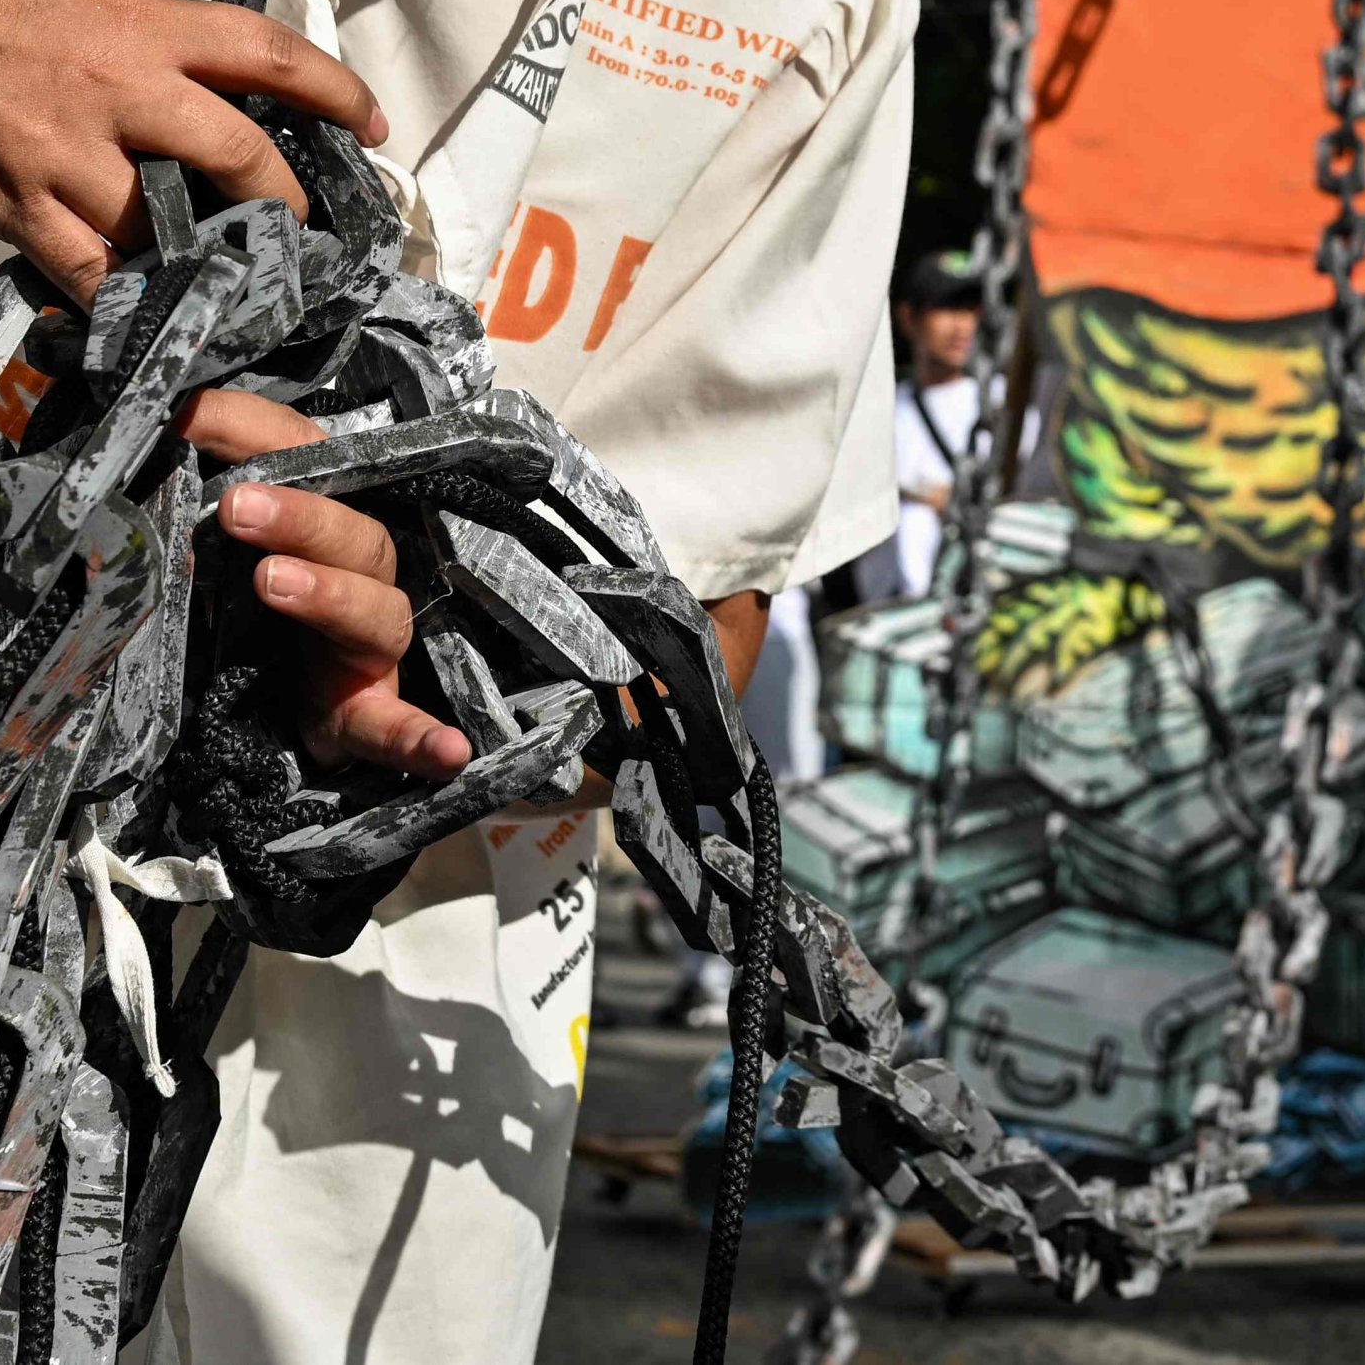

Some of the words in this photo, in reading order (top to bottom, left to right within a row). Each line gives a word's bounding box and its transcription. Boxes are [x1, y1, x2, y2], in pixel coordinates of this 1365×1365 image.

[578, 17, 616, 44] min
[618, 34, 635, 53] A
[710, 60, 746, 85] 6.5
[586, 45, 631, 77] Iron
[537, 876, 585, 933] 25
